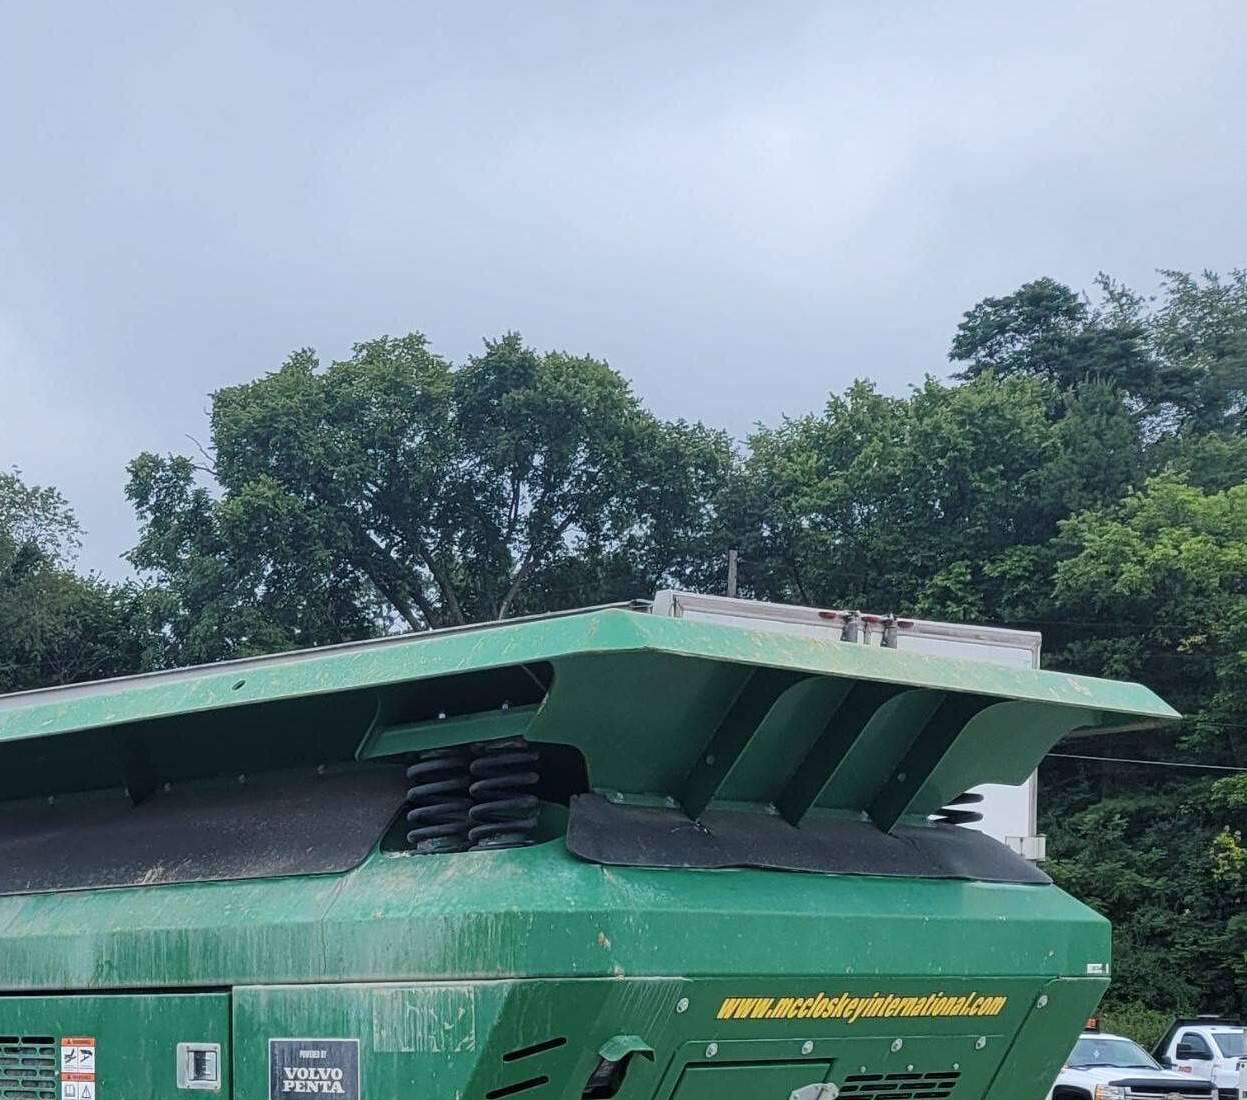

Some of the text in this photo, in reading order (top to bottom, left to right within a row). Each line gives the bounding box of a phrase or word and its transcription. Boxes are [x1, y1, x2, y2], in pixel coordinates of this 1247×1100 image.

[716, 991, 1007, 1024] www.mccloskeyinternational.com
[283, 1067, 343, 1080] VOLVO
[281, 1080, 345, 1093] PENTA
